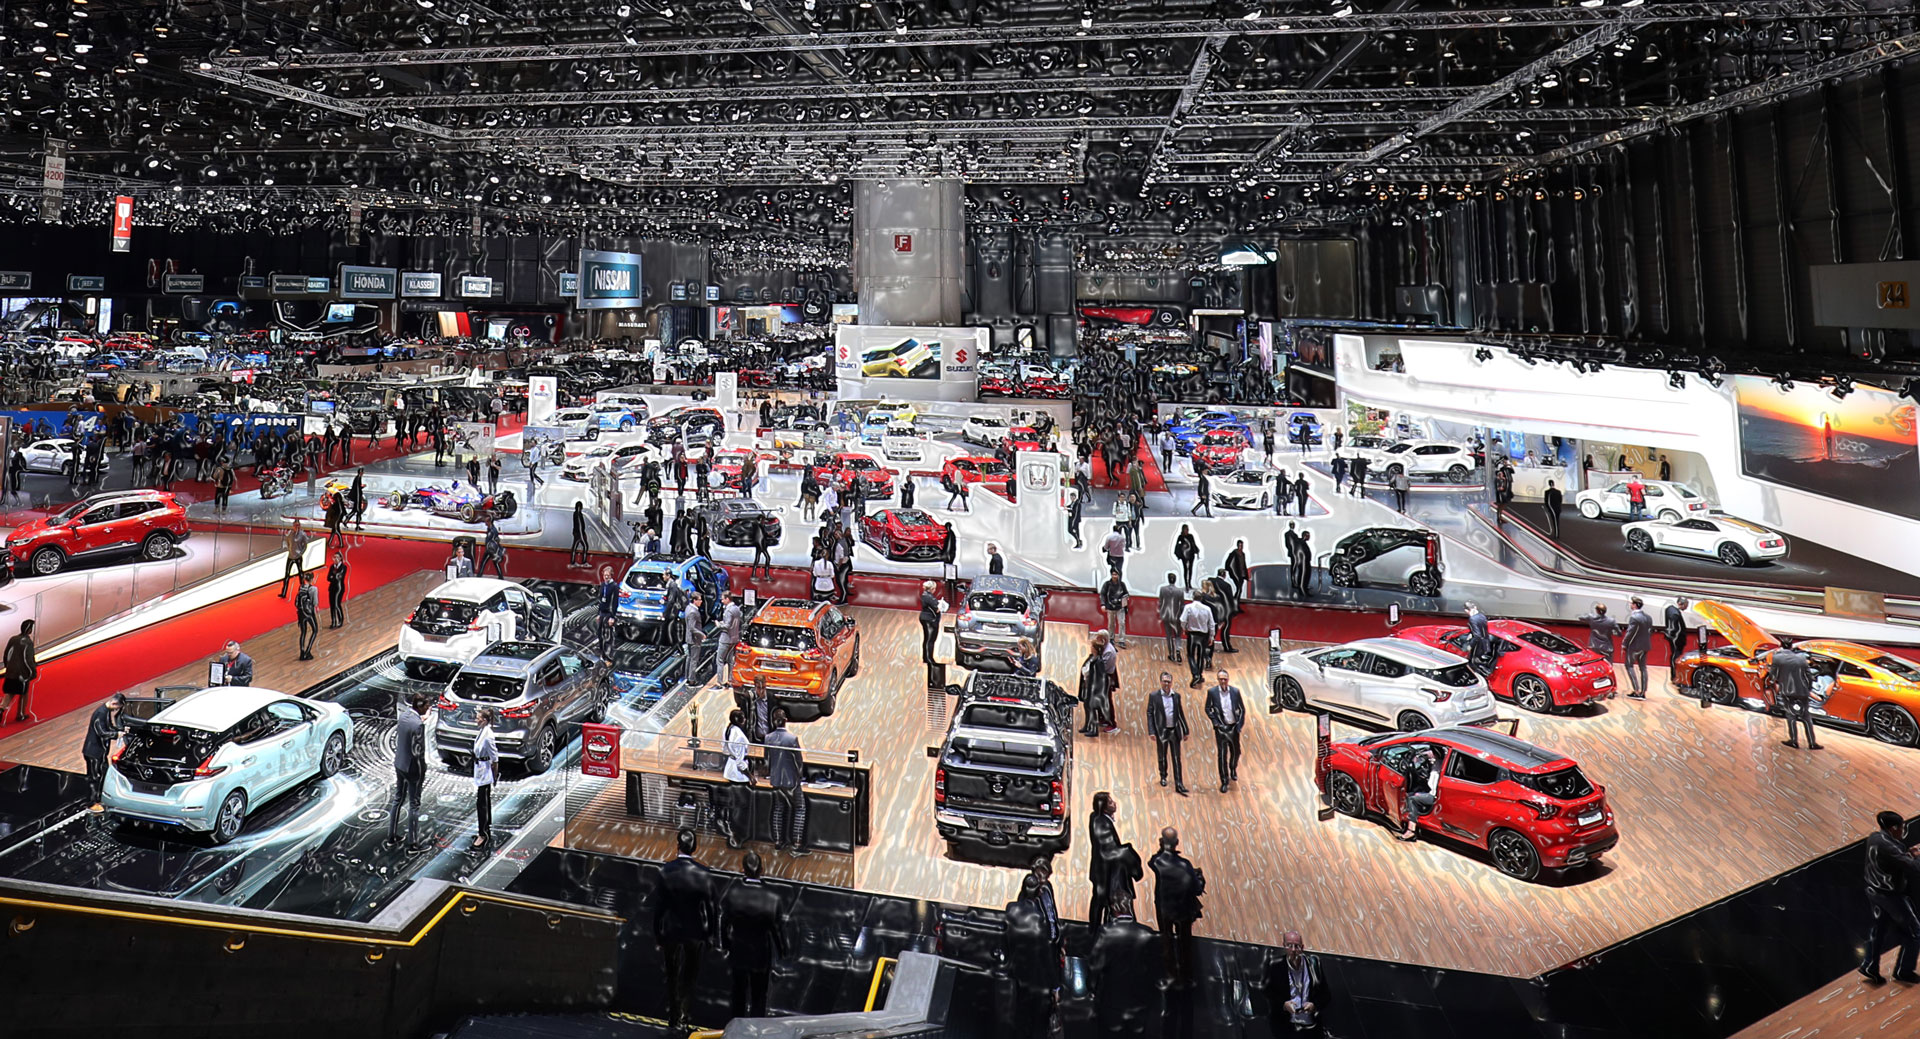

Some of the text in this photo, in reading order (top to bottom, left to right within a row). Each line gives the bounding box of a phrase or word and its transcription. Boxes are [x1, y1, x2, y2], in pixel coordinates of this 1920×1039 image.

[45, 170, 64, 180] 4200
[354, 276, 386, 289] HONDA
[409, 280, 435, 289] KLASSEN
[595, 269, 630, 290] NISSAN
[231, 417, 298, 426] APINE
[984, 821, 1013, 831] NISSAN
